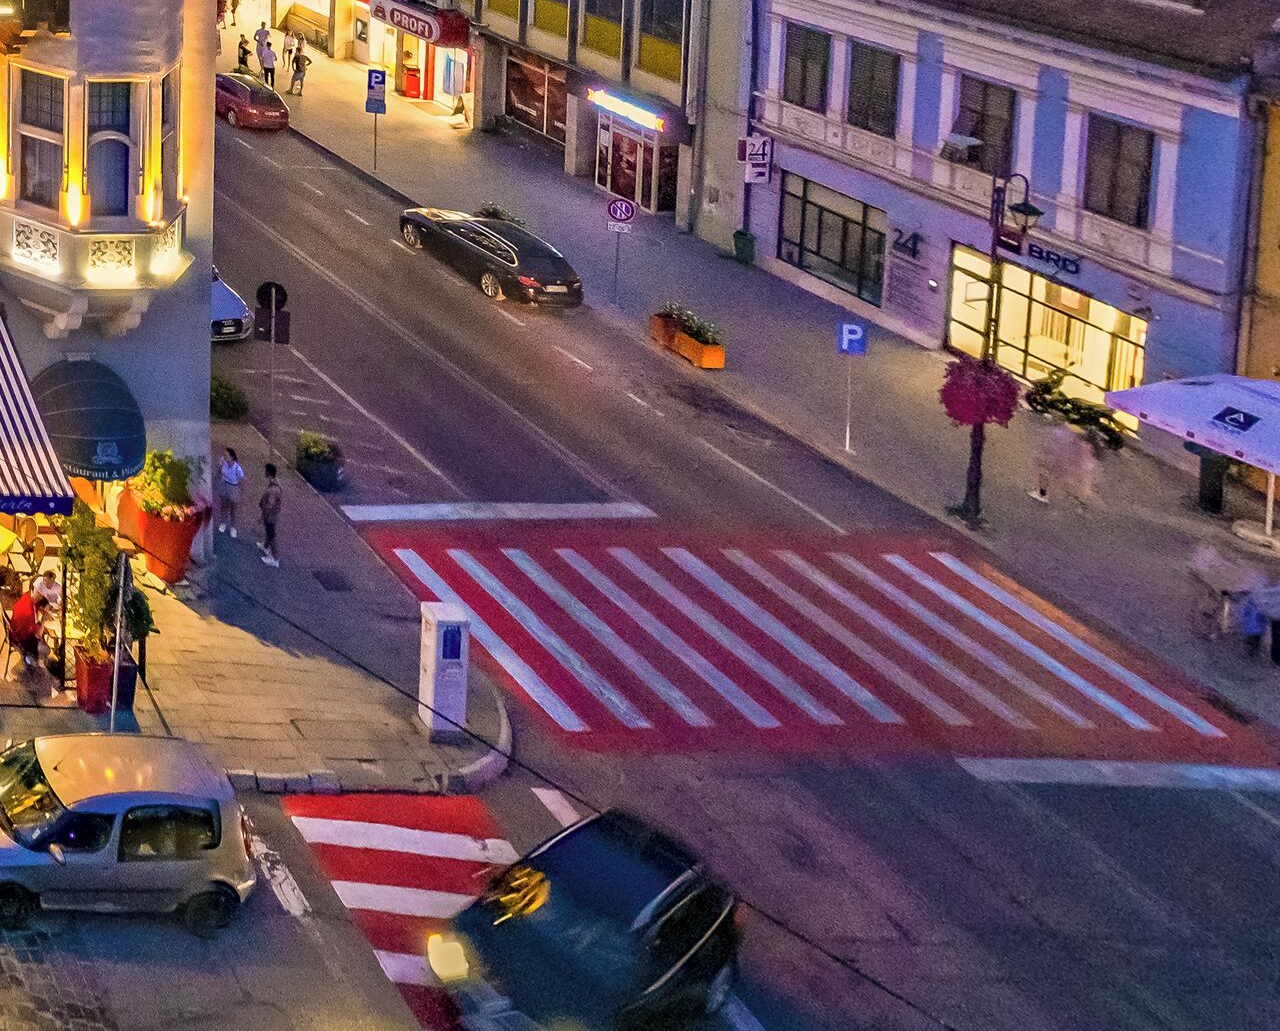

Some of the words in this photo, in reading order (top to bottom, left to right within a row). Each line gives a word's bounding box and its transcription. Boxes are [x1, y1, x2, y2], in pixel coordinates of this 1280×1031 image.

[393, 10, 429, 37] PROFI
[371, 73, 382, 86] P
[749, 140, 768, 161] 24
[1028, 243, 1081, 275] BRD
[842, 324, 863, 349] P
